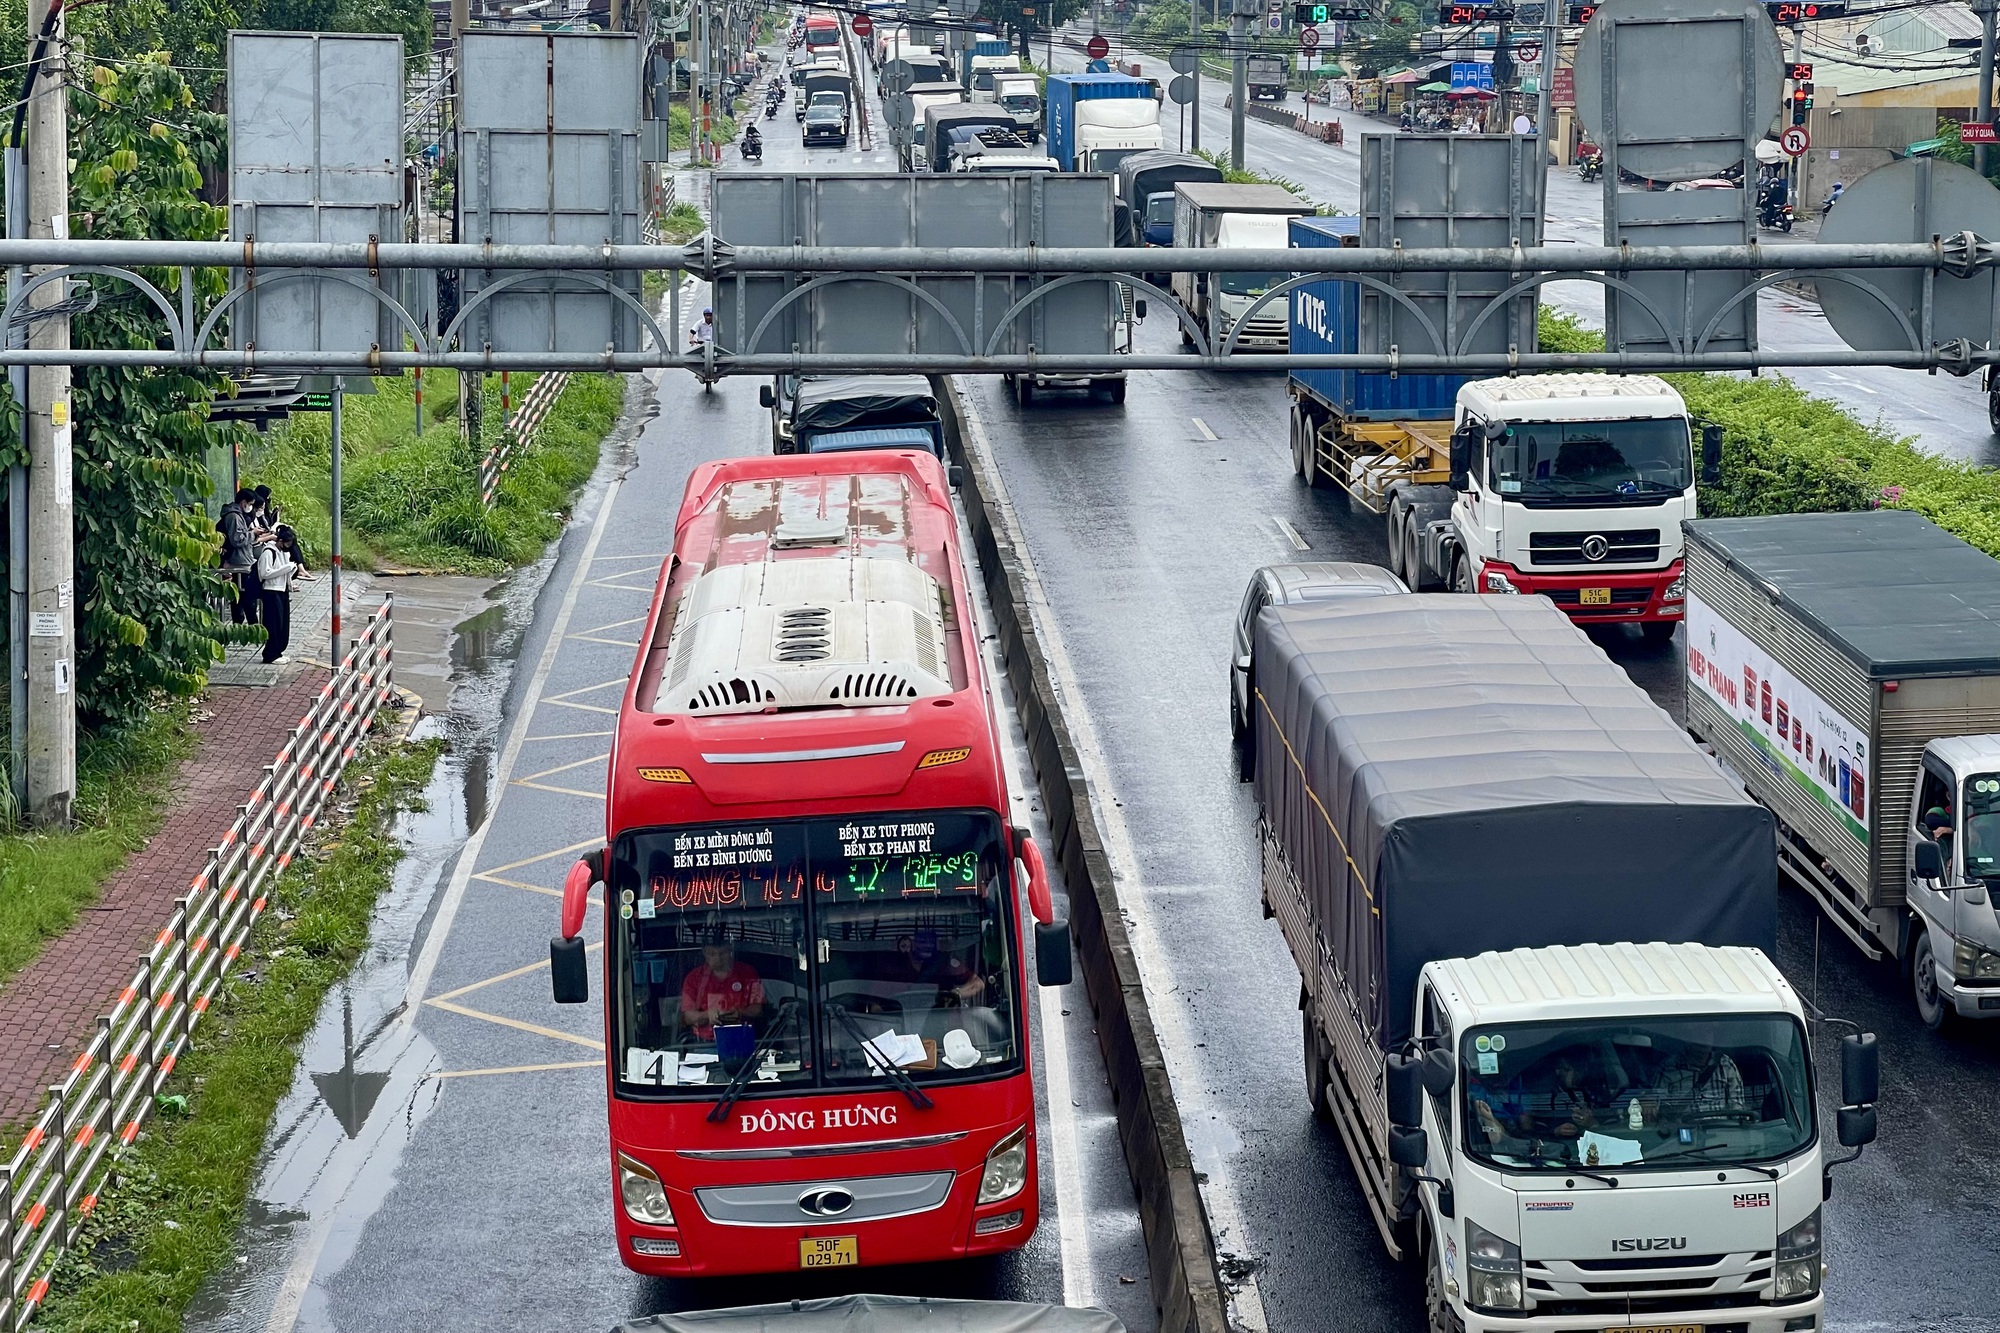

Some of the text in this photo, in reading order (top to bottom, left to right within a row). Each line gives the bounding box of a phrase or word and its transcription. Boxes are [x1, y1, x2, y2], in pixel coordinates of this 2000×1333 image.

[1313, 5, 1328, 22] 19
[1451, 7, 1472, 23] 24
[1778, 5, 1799, 20] 24
[1793, 65, 1811, 79] 25
[1588, 589, 1602, 597] 51C
[839, 822, 936, 841] BẾN XE TUY PHONG
[675, 833, 692, 851] BẾN
[694, 836, 706, 849] XE
[707, 831, 730, 848] MIỀN
[731, 831, 755, 847] ĐÔNG
[844, 839, 866, 857] BẾN
[868, 844, 885, 855] XE
[886, 841, 916, 854] PHAN
[673, 848, 773, 868] BẾN XE BÌNH DƯƠNG
[644, 1054, 665, 1085] 4
[739, 1103, 898, 1134] ĐÔNG HƯNG
[816, 1239, 841, 1252] 50F
[1611, 1236, 1687, 1252] ISUZU
[806, 1252, 851, 1267] 029.71
